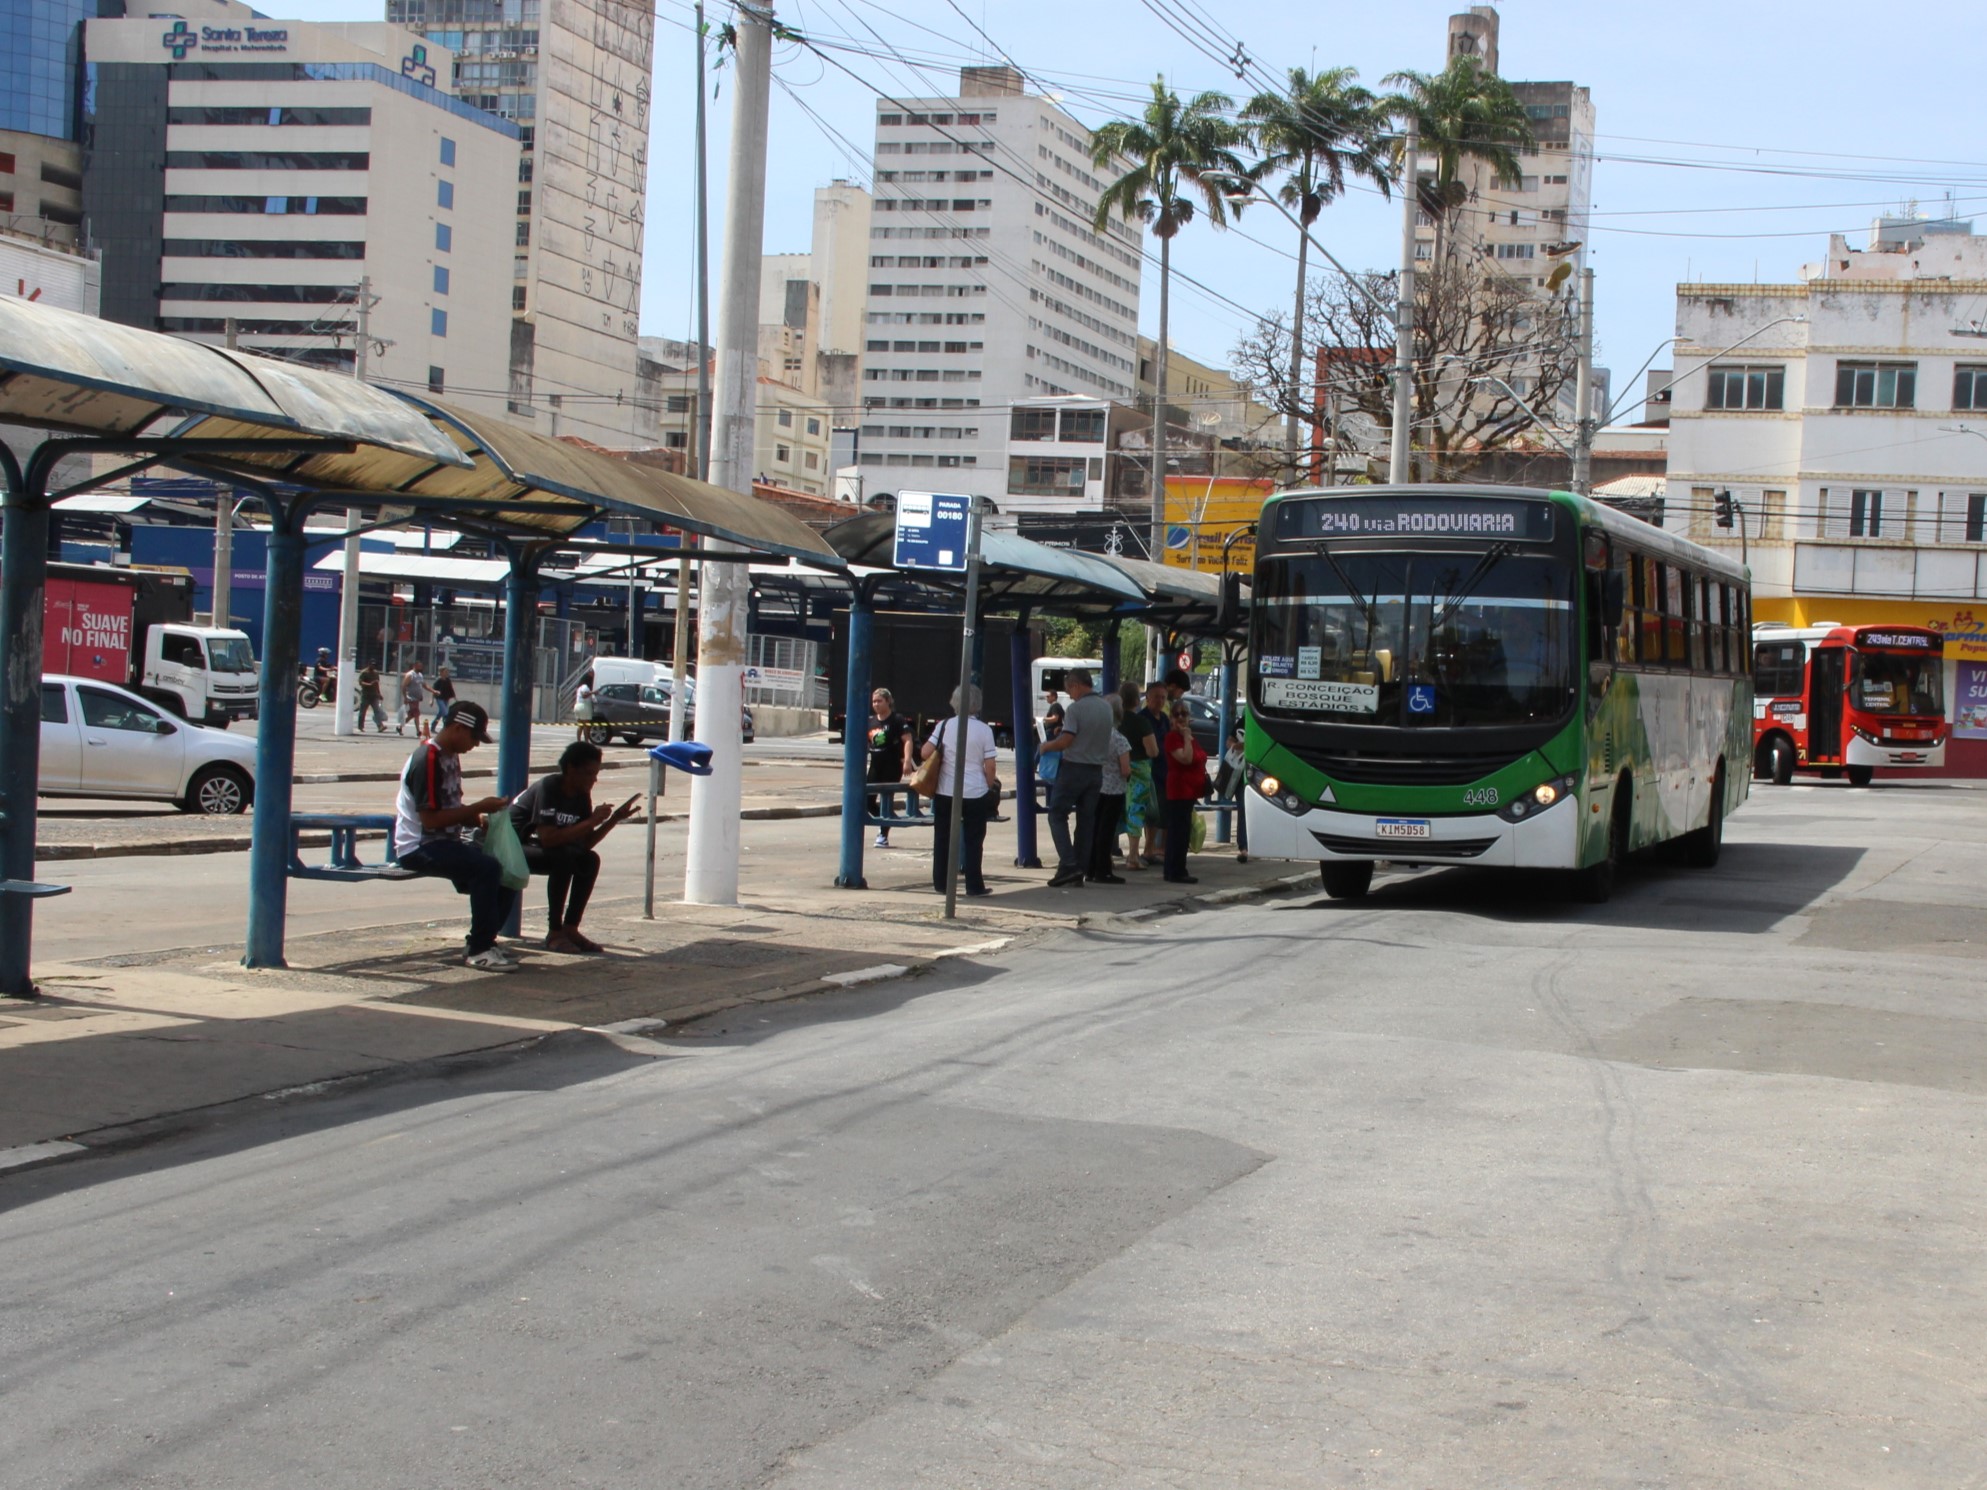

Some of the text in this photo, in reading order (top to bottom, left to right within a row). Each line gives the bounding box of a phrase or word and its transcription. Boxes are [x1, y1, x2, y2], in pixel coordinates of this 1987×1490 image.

[202, 26, 288, 42] Santa Tereza
[201, 44, 231, 53] Hospital
[938, 501, 962, 509] PARADA
[937, 511, 963, 520] 00180
[1321, 513, 1515, 532] 240 via RODOVIARIA
[82, 612, 128, 633] SUAVE
[61, 627, 127, 651] NO FINAL
[1267, 681, 1374, 696] R. CONCEIÇÃO
[1285, 692, 1353, 703] BOSQUE
[1463, 787, 1498, 805] 448
[1381, 824, 1425, 836] KIM5D58
